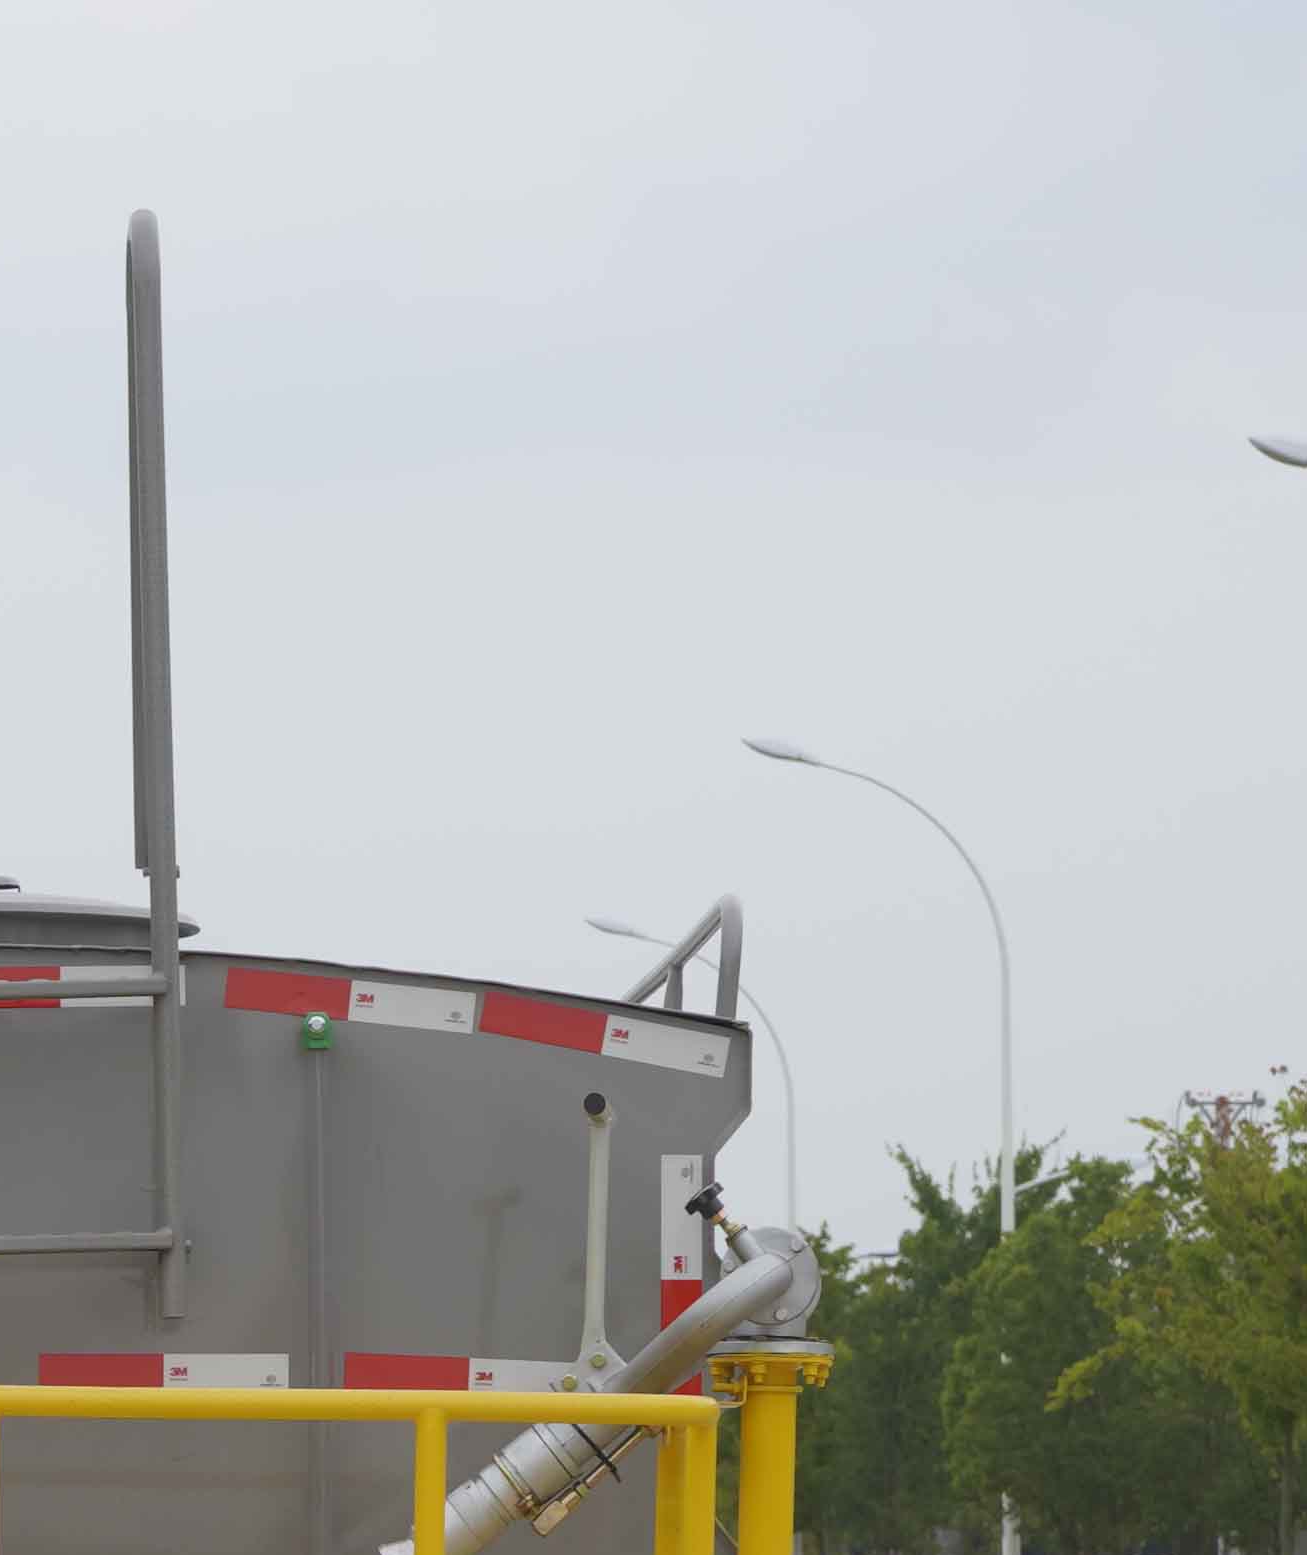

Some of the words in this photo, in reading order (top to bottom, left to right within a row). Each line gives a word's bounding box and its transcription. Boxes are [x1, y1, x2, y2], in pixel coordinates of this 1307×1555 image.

[356, 993, 375, 1003] 3M
[610, 1028, 629, 1040] 3M
[169, 1367, 188, 1378] 3M
[475, 1371, 493, 1381] 3M
